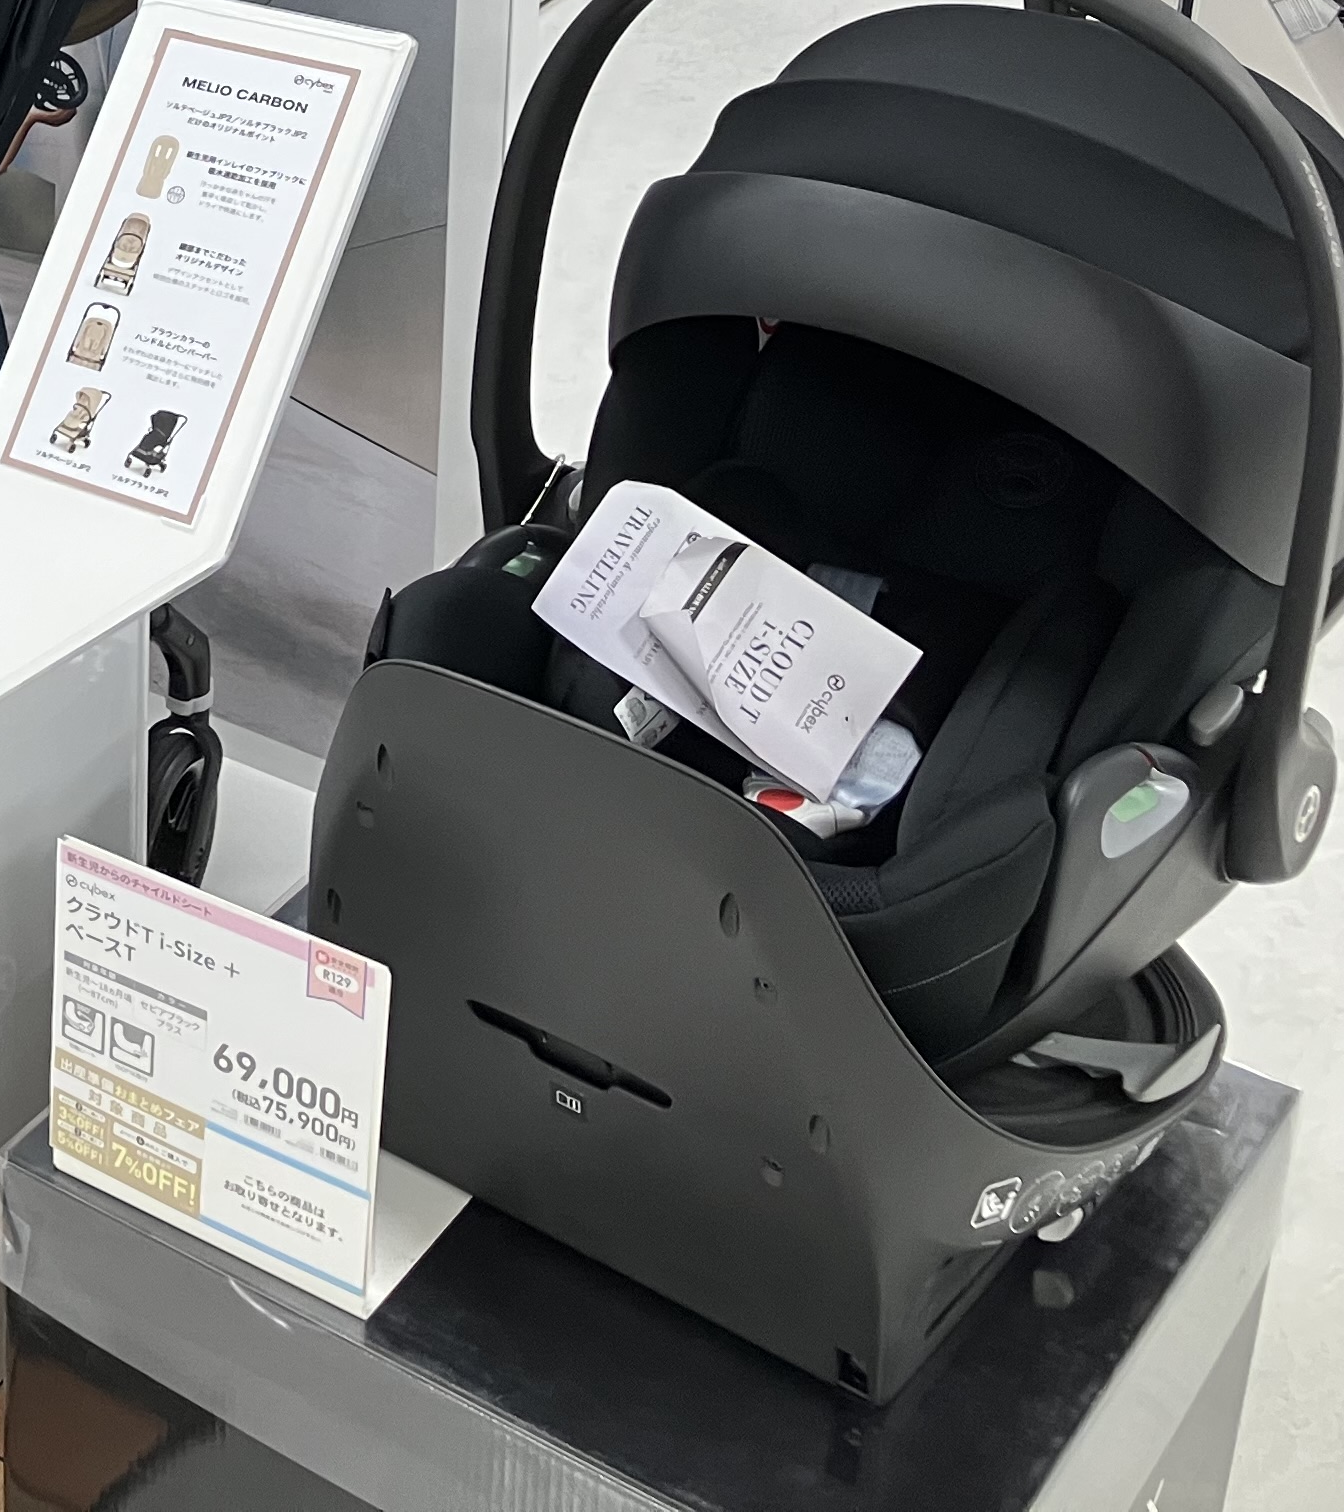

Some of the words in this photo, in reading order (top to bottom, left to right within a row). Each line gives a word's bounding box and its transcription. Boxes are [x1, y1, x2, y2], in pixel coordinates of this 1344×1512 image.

[182, 76, 232, 97] MELIO
[236, 89, 309, 114] CARBON
[570, 505, 653, 614] TRAVELLING
[750, 619, 815, 703] CLOUD
[739, 705, 761, 726] T
[79, 879, 116, 902] cybex
[65, 923, 136, 962] ベースT
[159, 932, 216, 971] i-Size
[322, 968, 352, 989] R129
[213, 1043, 359, 1130] 69,000円
[111, 1140, 196, 1207] 7%OFF!
